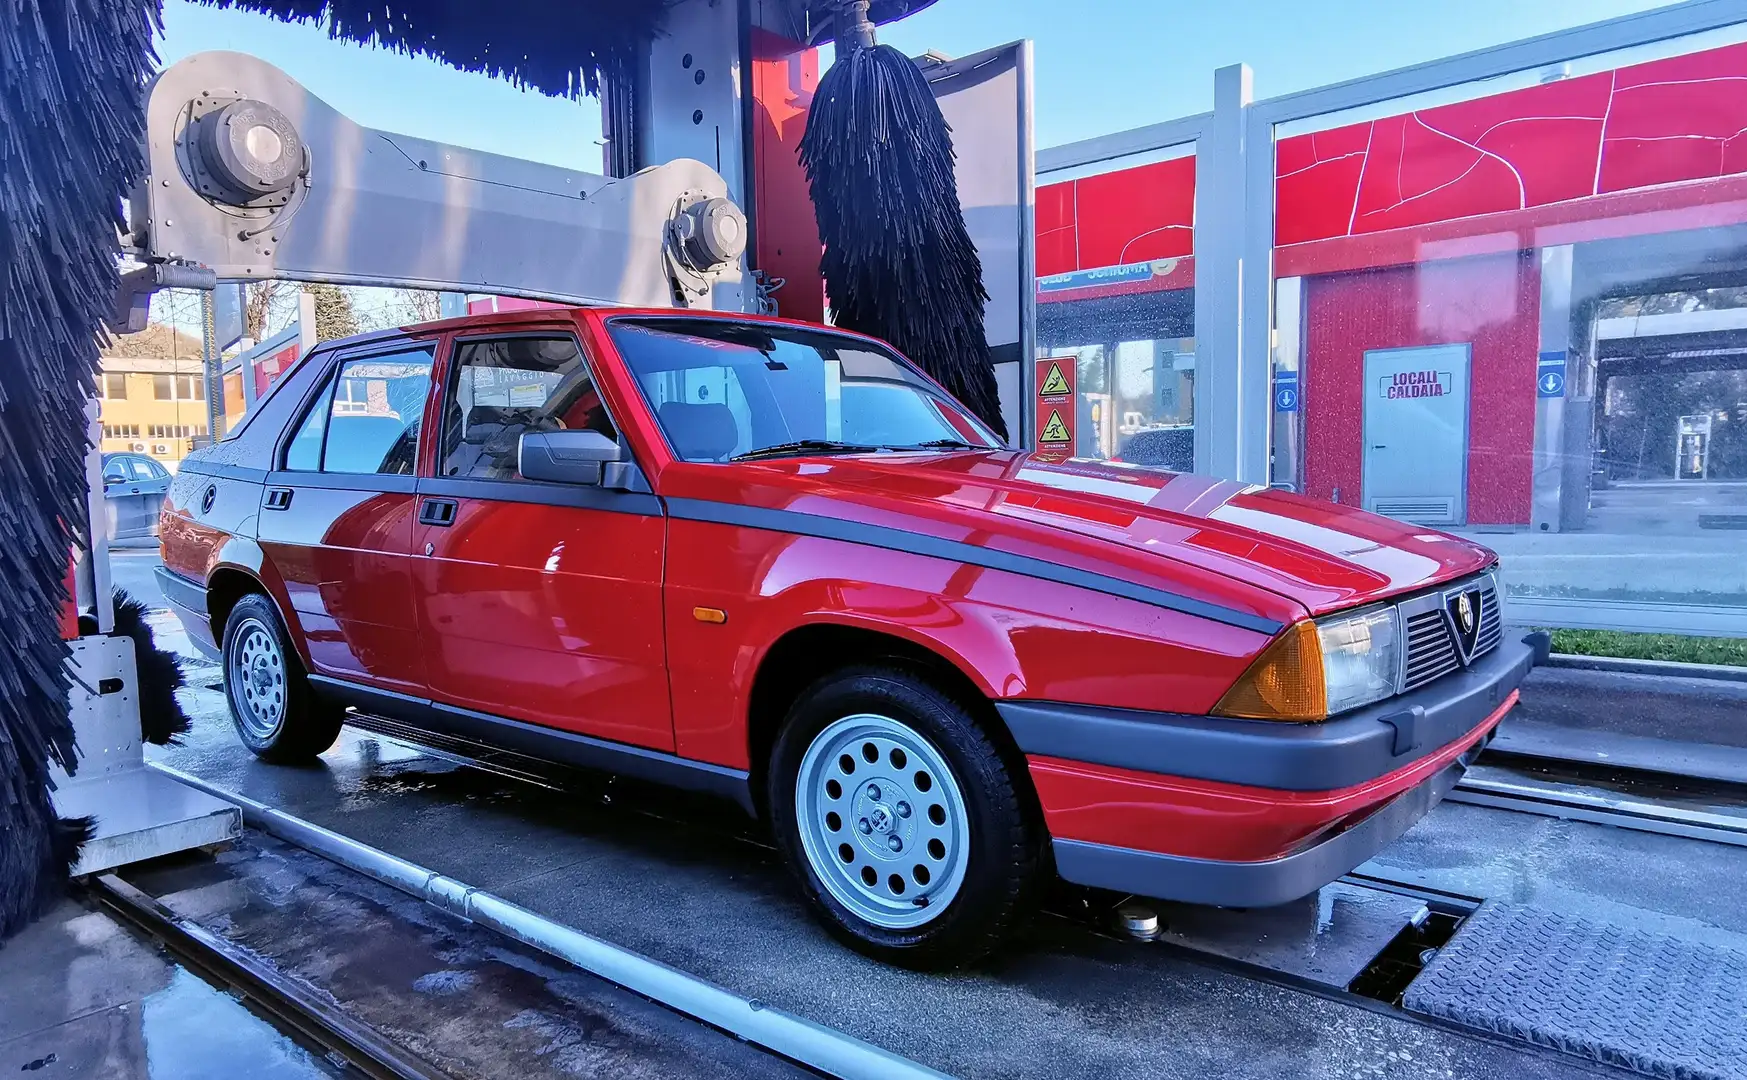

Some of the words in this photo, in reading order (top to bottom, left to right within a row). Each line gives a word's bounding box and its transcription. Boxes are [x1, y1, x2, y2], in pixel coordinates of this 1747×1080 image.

[499, 371, 545, 384] LAVAGGIO
[1392, 370, 1438, 386] LOCALI
[1387, 383, 1443, 400] CALDAIA
